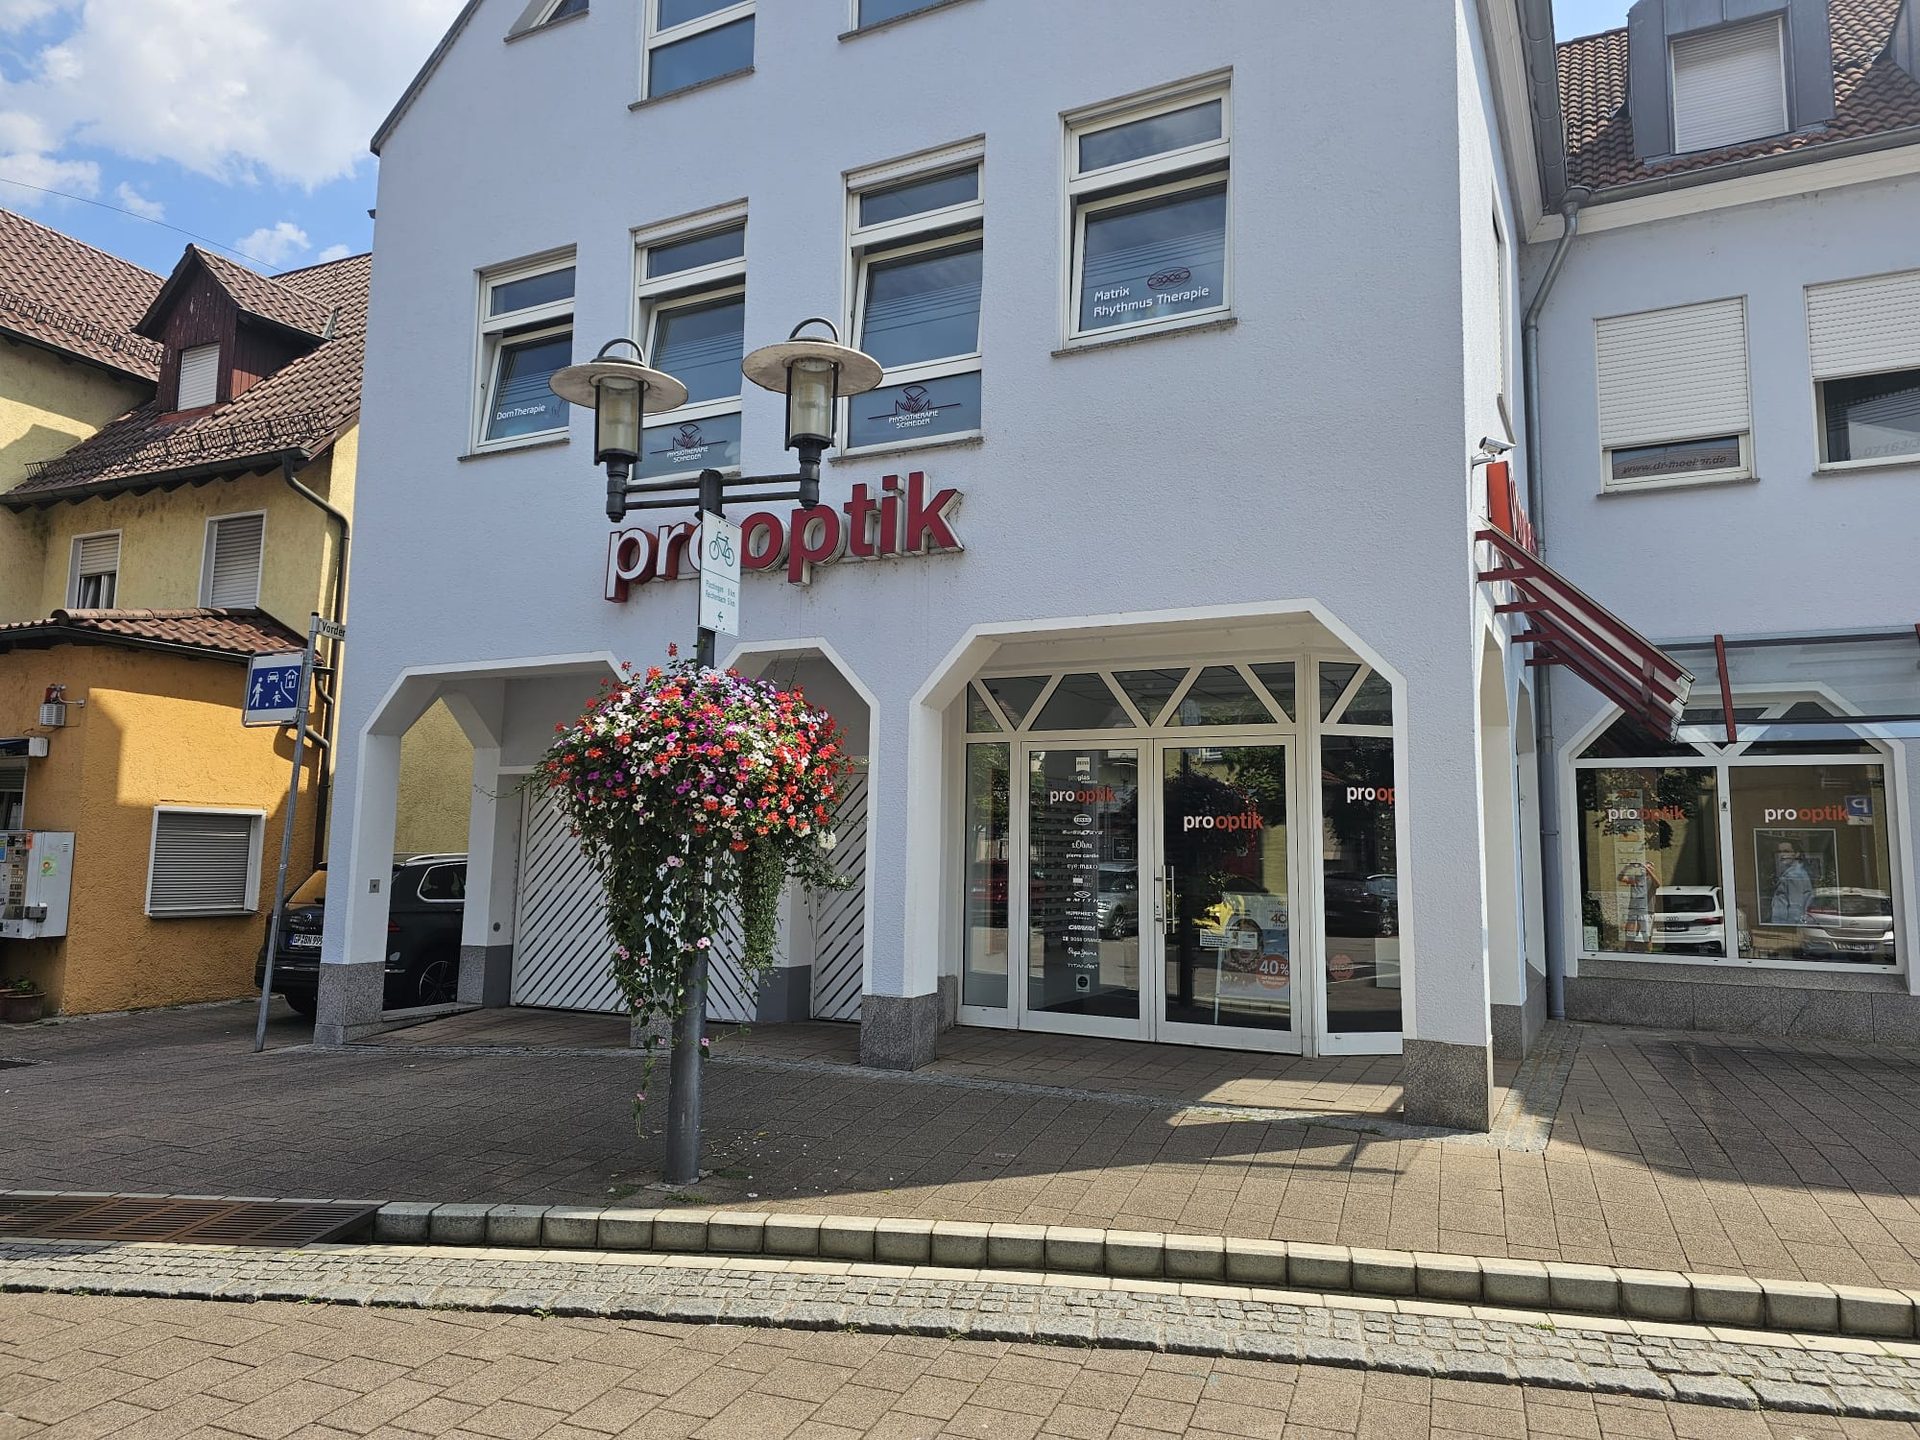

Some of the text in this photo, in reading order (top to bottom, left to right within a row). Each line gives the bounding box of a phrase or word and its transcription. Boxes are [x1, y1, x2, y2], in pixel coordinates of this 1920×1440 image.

[1093, 286, 1210, 317] Rhythmus Therapie
[1094, 286, 1130, 302] Matrix
